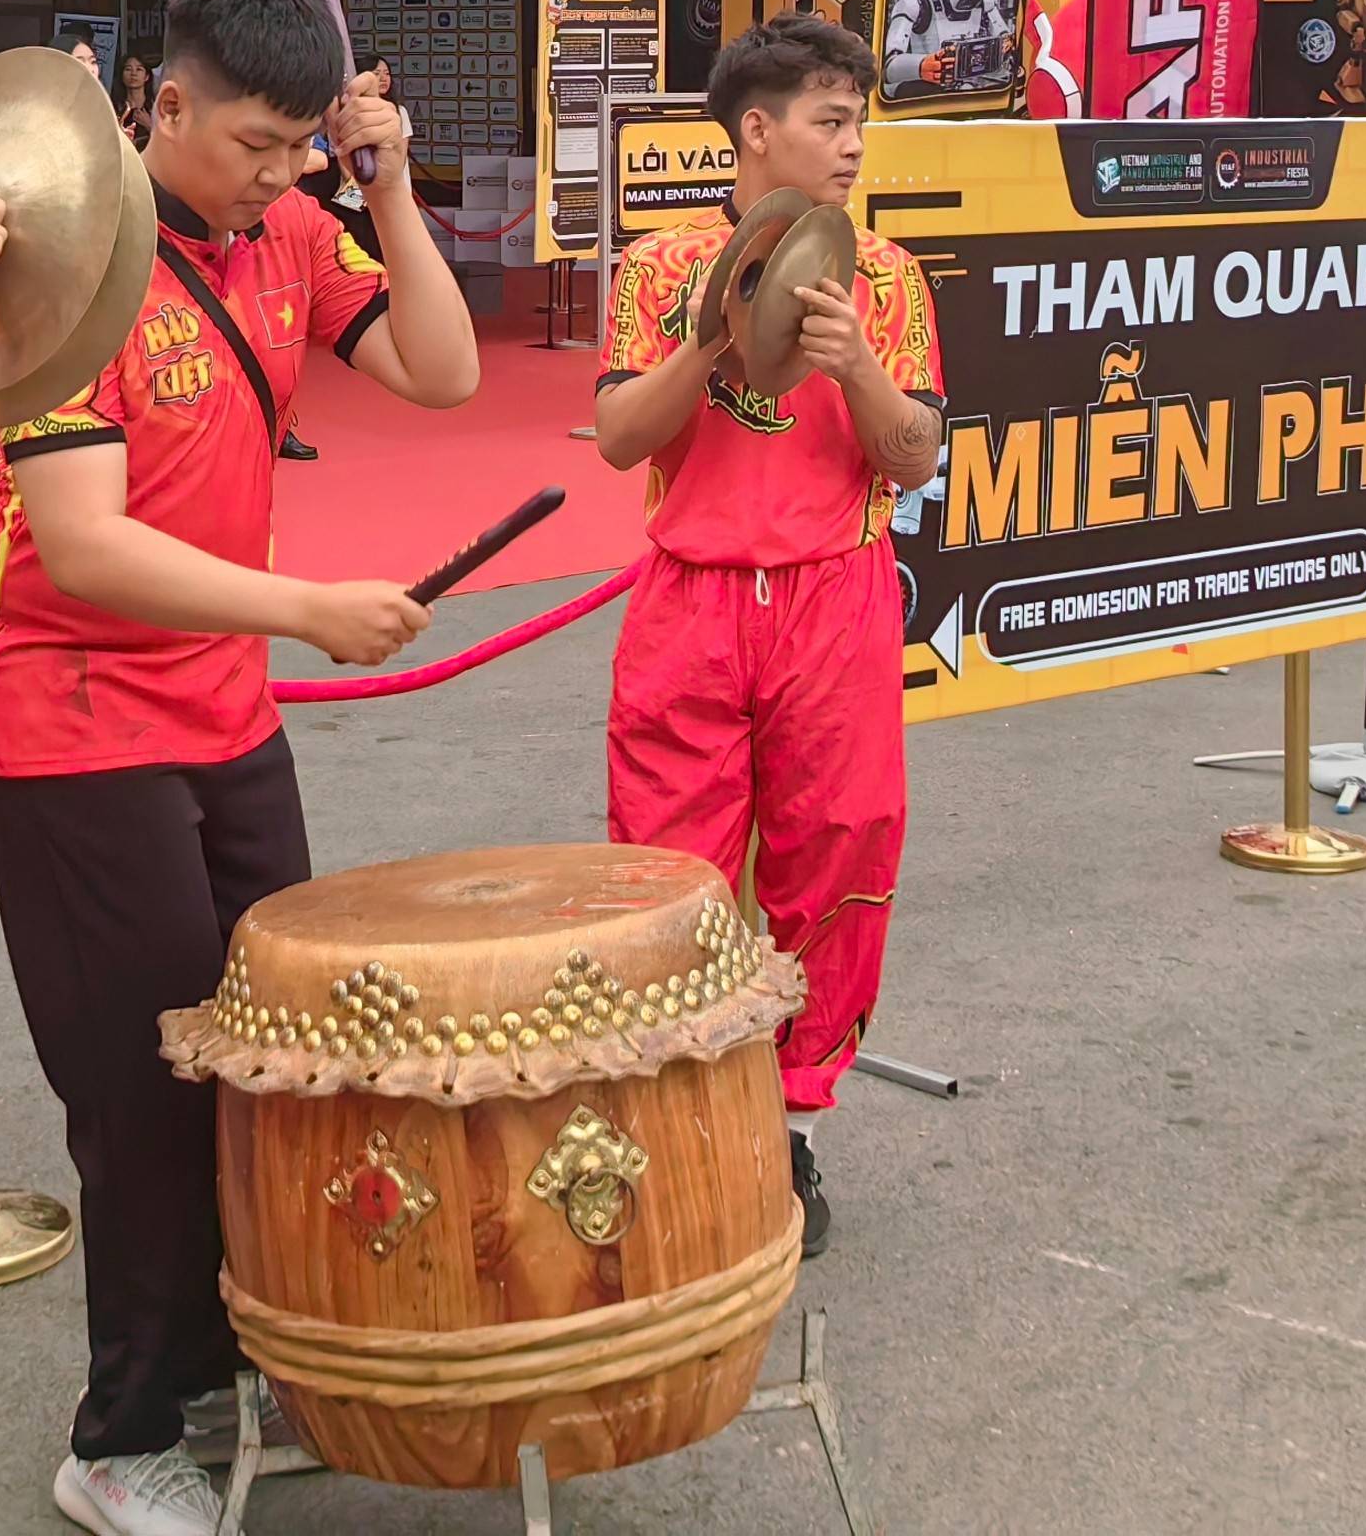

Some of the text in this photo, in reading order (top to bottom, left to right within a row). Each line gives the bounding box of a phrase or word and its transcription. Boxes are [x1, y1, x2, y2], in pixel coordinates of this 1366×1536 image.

[626, 189, 662, 202] MAIN
[628, 144, 735, 175] LỐI VÀO
[994, 255, 1195, 336] THAM
[939, 340, 1237, 551] MIỄN
[999, 605, 1044, 632] FREE
[1051, 588, 1151, 623] ADMISSION
[1156, 580, 1190, 605] FOR
[1194, 570, 1249, 600] TRADE
[1254, 557, 1326, 592] VISITORS
